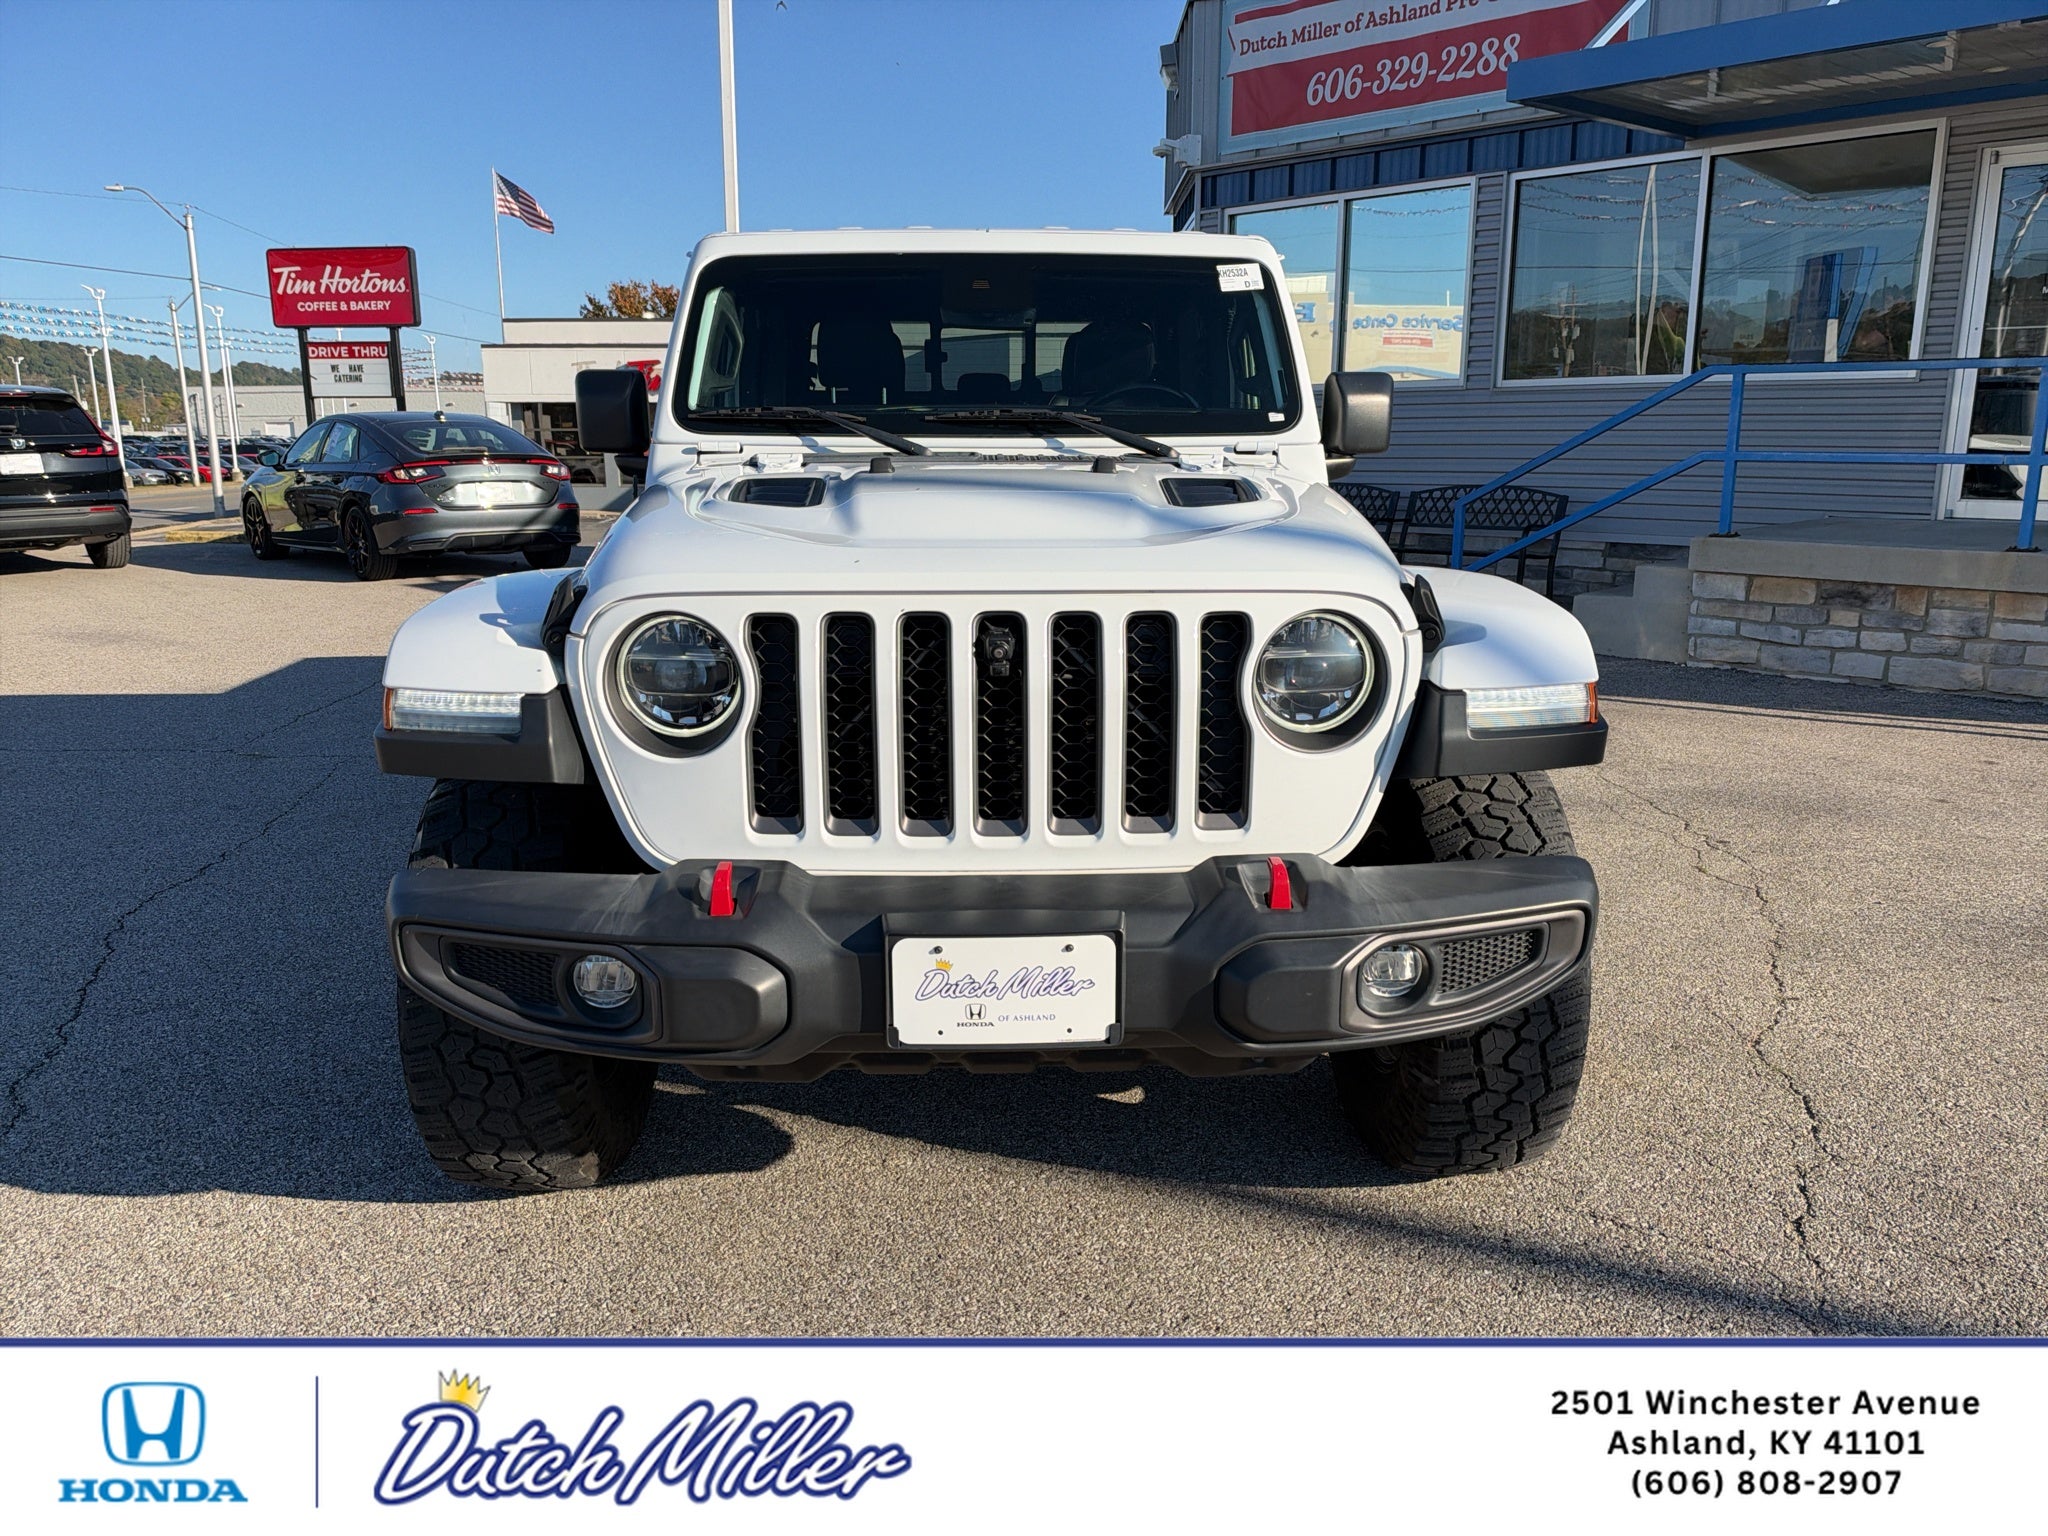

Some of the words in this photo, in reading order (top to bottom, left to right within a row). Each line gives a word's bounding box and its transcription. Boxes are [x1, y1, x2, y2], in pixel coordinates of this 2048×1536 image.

[1239, 30, 1288, 56] Dutch
[1291, 18, 1341, 45] Miller
[1344, 13, 1363, 32] of
[1364, 0, 1441, 29] Ashland
[1306, 33, 1521, 106] 606-329-2288
[272, 266, 316, 295] Tim
[297, 301, 338, 312] COFFEE
[340, 302, 348, 311] &
[350, 300, 391, 311] BAKERY
[308, 346, 349, 358] DRIVE
[352, 345, 388, 357] THRU
[330, 364, 340, 373] WE
[348, 364, 365, 373] HAVE
[333, 374, 363, 383] CATERING
[915, 968, 999, 1001] Dutch
[997, 966, 1096, 1000] Miller
[998, 1014, 1009, 1022] OF
[1012, 1013, 1057, 1022] ASHLAND
